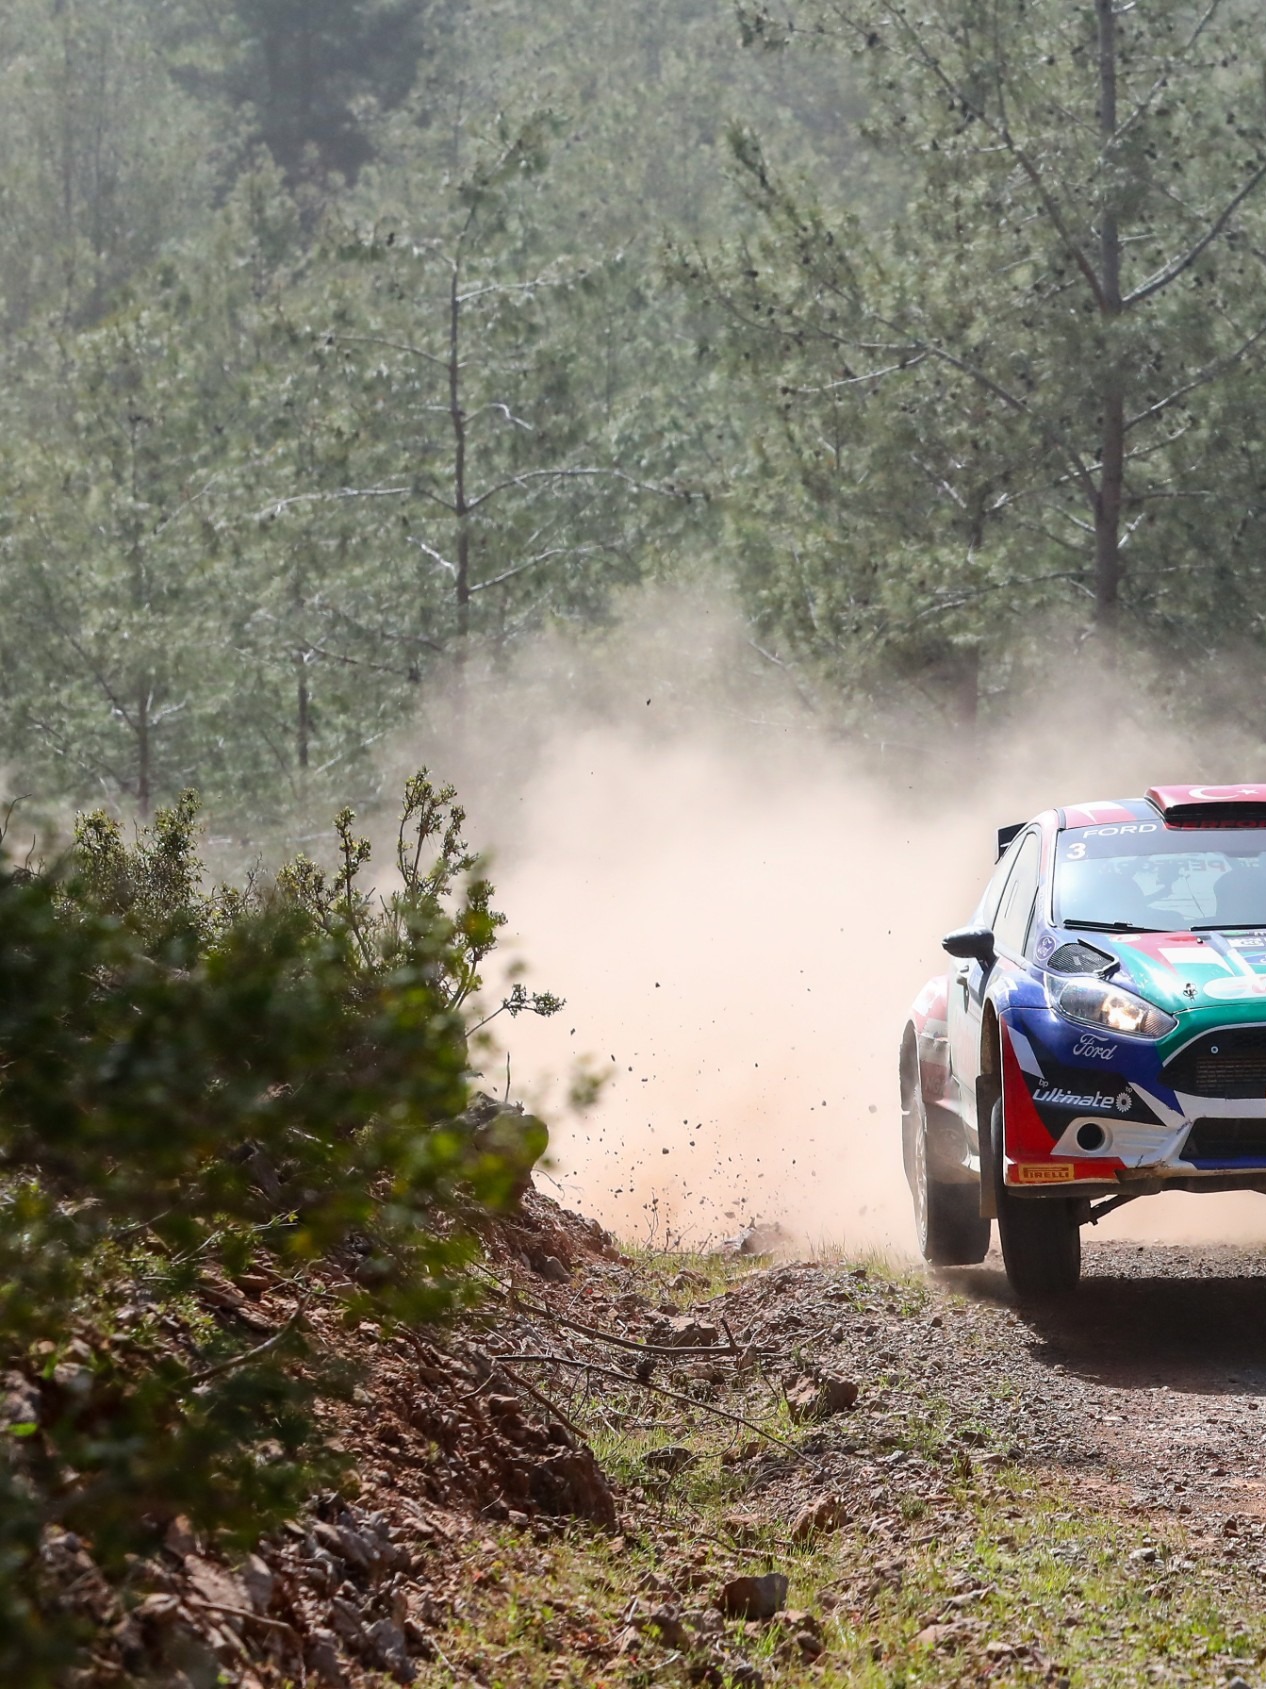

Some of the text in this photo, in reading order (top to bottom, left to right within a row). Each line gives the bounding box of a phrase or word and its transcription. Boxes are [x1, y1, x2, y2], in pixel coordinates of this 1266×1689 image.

[1083, 823, 1157, 839] FORD
[1066, 843, 1087, 859] 3
[1073, 1033, 1118, 1060] Ford
[1039, 1079, 1049, 1087] bp
[1032, 1088, 1115, 1109] ultimate
[1023, 1167, 1070, 1178] PIRELLI
